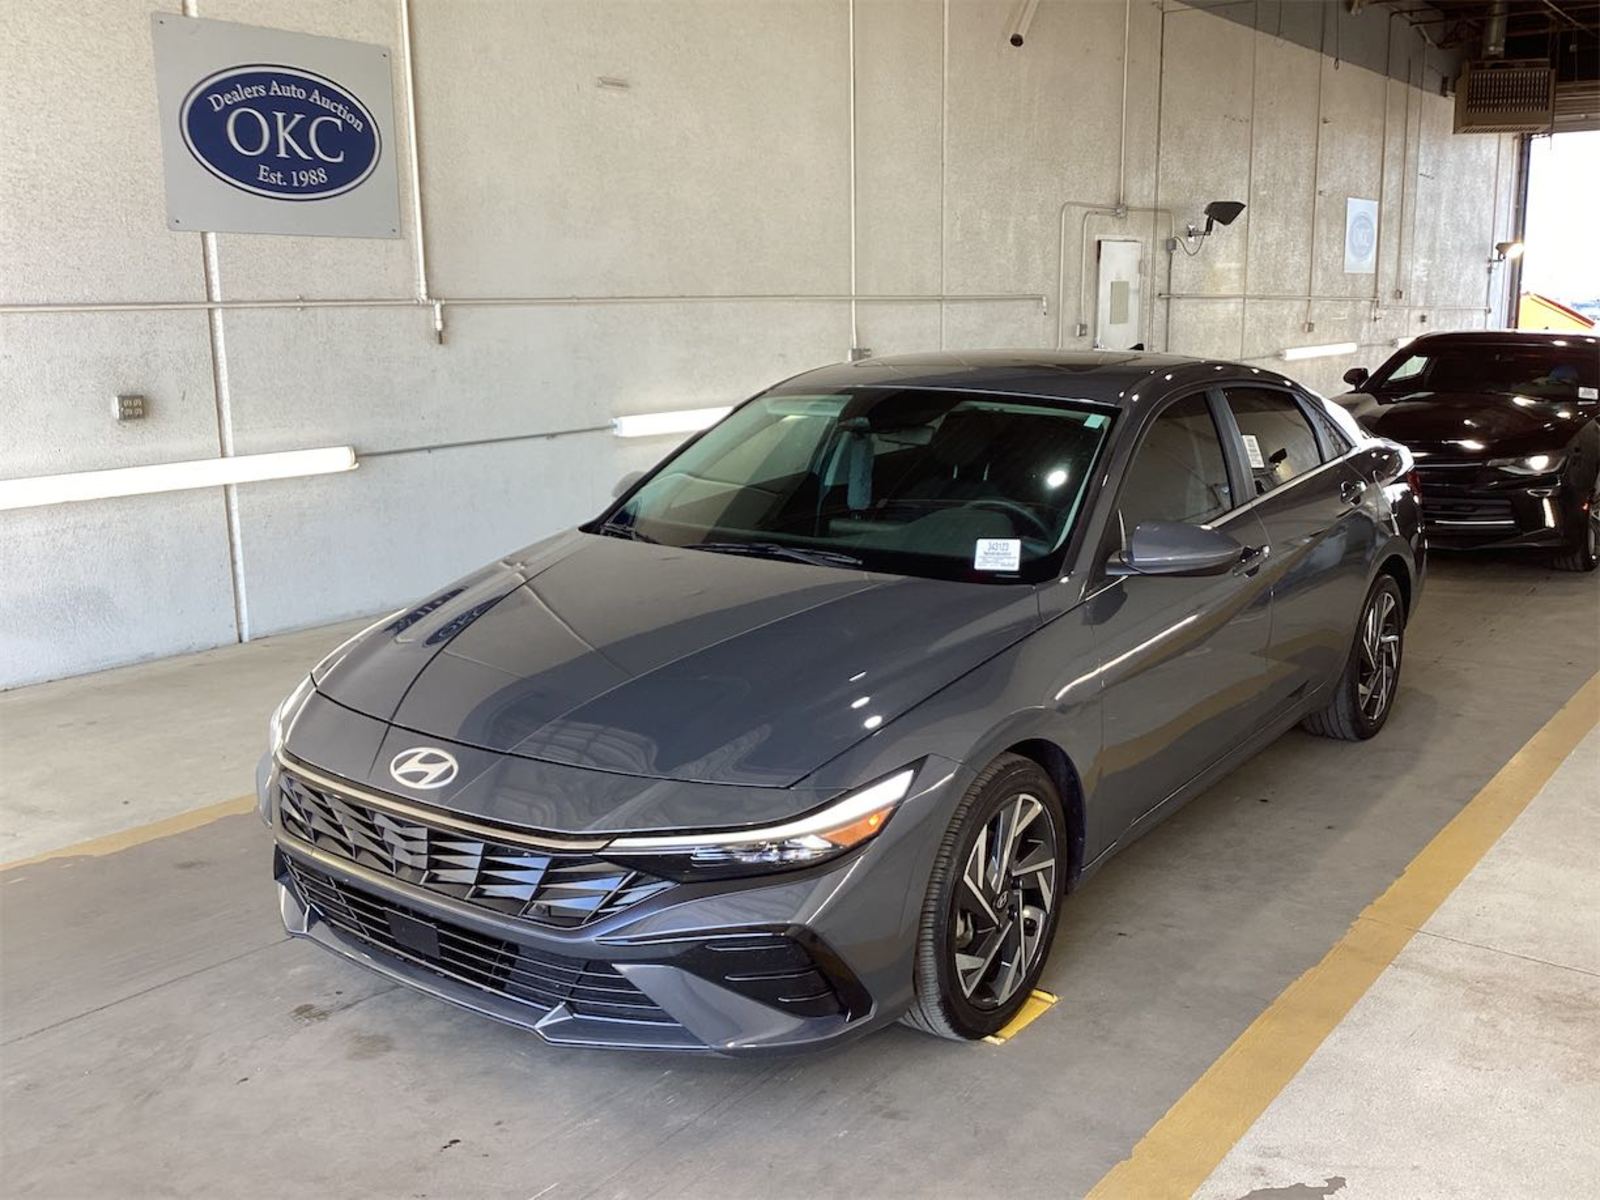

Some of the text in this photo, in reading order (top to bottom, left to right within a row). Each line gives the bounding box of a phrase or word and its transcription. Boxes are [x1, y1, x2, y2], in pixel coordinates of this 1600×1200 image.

[208, 80, 364, 133] Dealers Auto Auction
[226, 107, 345, 163] OKC
[257, 164, 328, 187] Est. 1988
